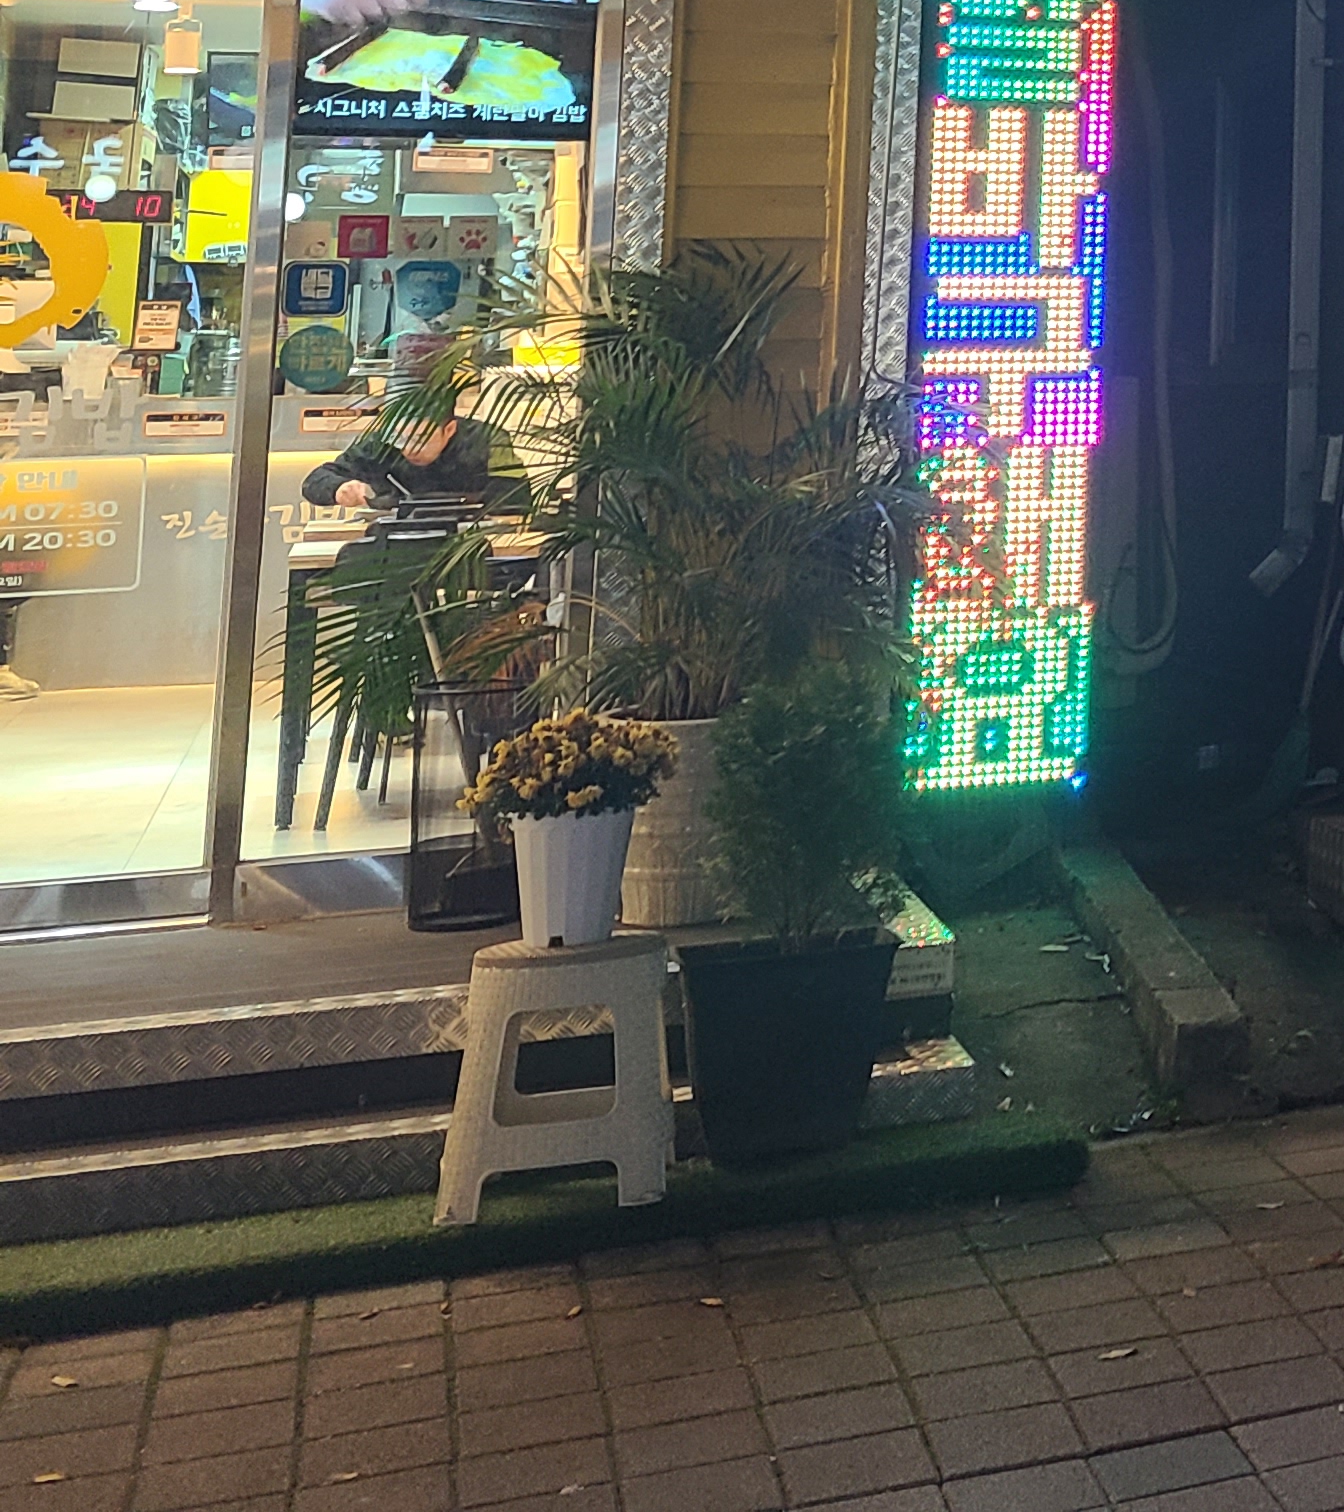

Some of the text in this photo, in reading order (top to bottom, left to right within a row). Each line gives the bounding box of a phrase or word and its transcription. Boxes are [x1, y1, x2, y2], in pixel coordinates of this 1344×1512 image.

[314, 98, 386, 120] 시그니처
[552, 102, 588, 123] 김밥
[16, 468, 78, 491] 안내
[24, 499, 119, 522] 07:30
[22, 528, 117, 552] 20:30
